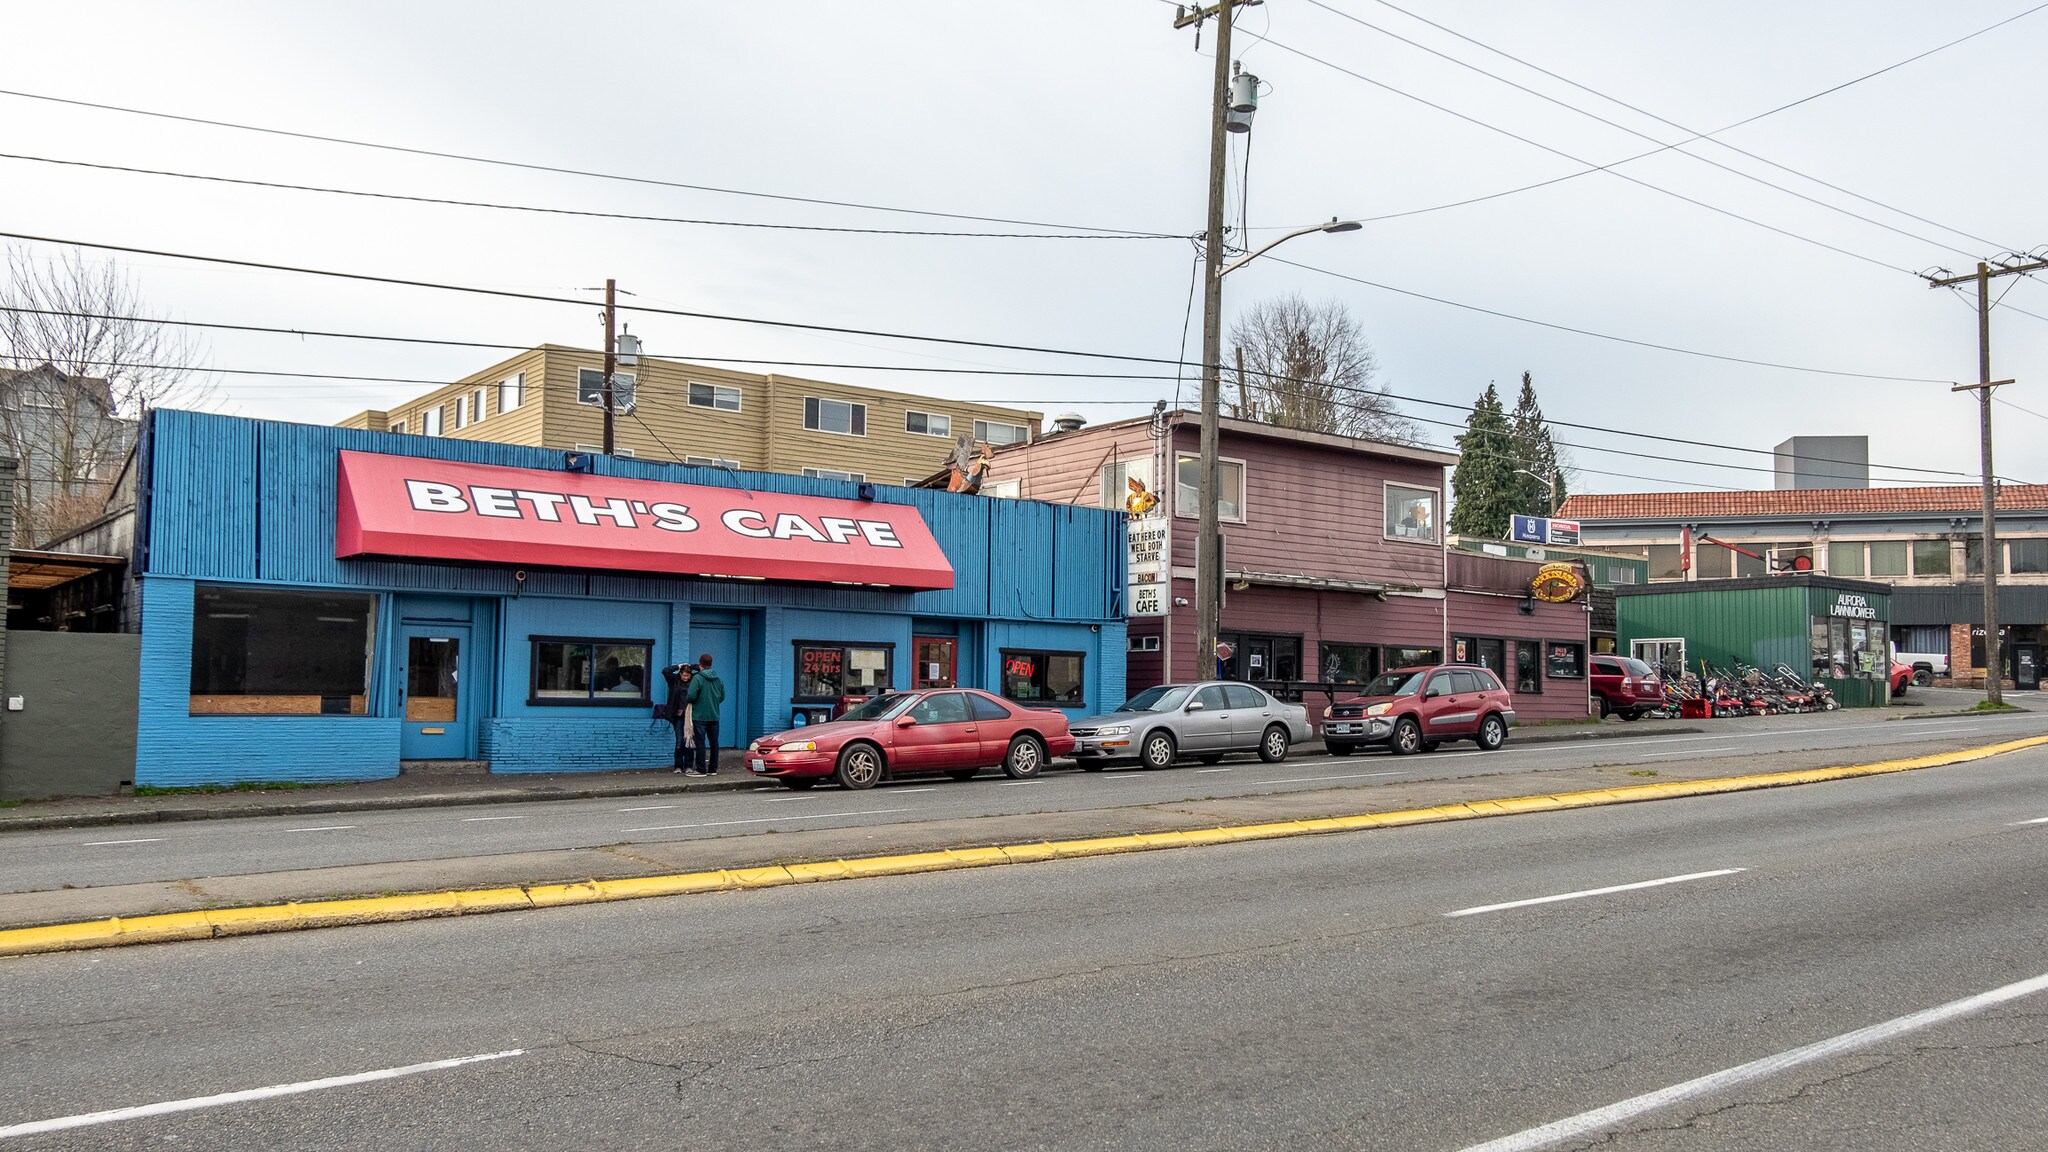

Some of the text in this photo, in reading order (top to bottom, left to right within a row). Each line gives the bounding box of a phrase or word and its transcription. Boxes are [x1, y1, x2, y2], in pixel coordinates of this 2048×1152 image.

[404, 479, 904, 549] BETH'S CAFE
[1128, 529, 1166, 543] EAT HERE OR
[1148, 541, 1163, 551] BOTH
[1136, 551, 1159, 563] STARVE
[1136, 600, 1158, 613] CAFE
[1837, 594, 1867, 607] AURORA
[1830, 605, 1876, 619] LAWNMOWER
[803, 651, 841, 662] OPEN
[803, 663, 841, 673] 24 hrs
[1006, 659, 1036, 678] OPEN
